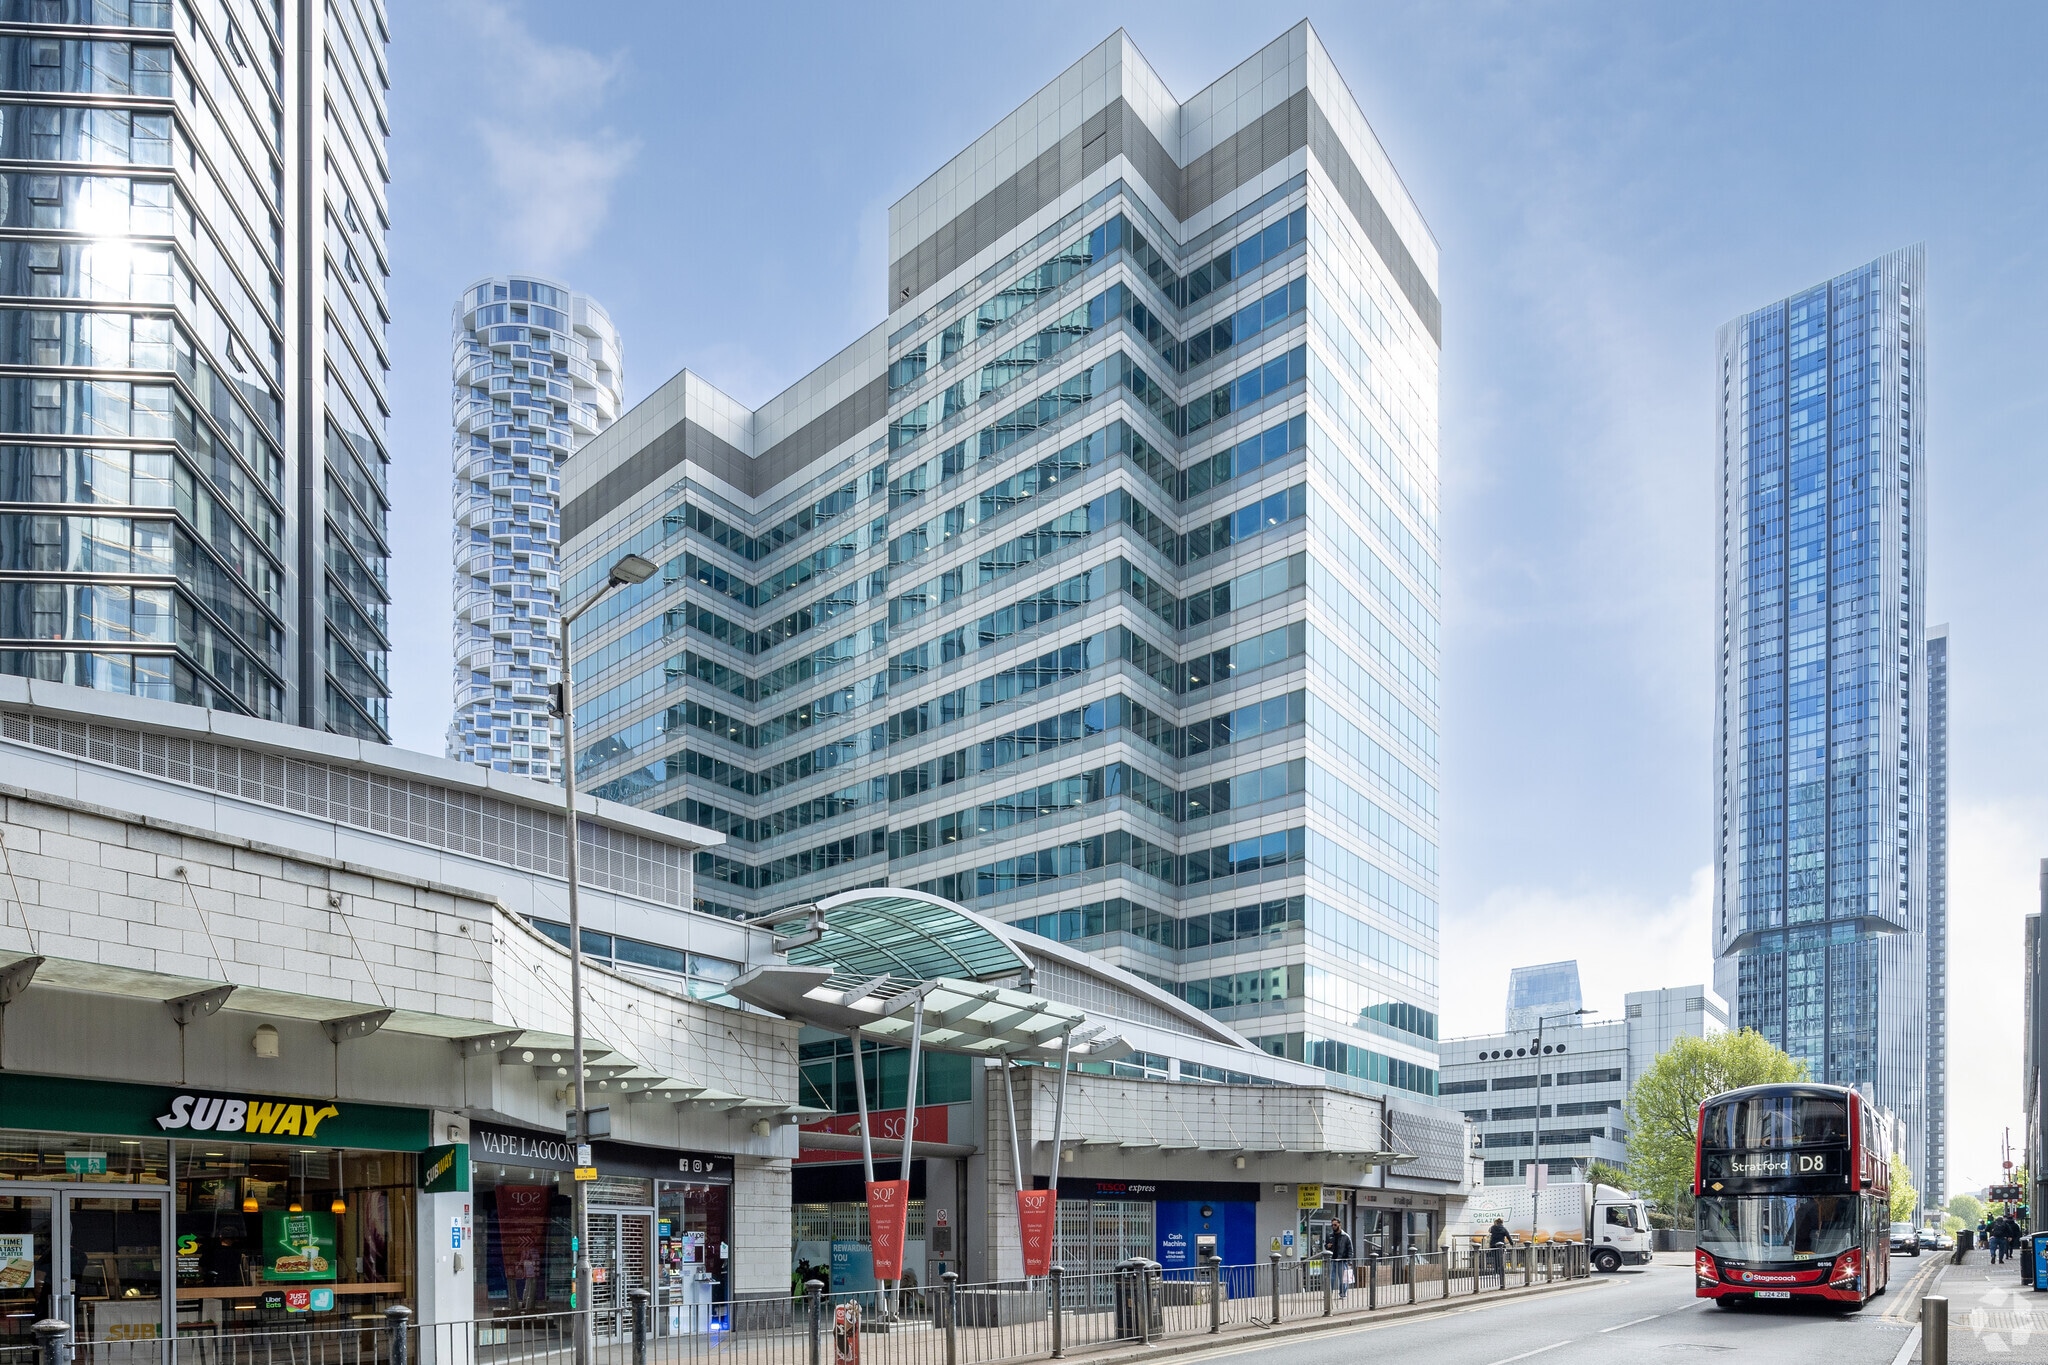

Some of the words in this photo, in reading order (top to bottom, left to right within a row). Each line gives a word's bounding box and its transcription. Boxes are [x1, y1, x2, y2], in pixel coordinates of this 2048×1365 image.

[156, 1095, 339, 1138] SUBWAY
[480, 1131, 518, 1156] VAPE
[521, 1137, 576, 1163] LAGOON
[425, 1149, 455, 1186] SUBWAY
[1731, 1160, 1789, 1172] Stratford
[1800, 1155, 1824, 1172] D8
[873, 1187, 895, 1203] SQP
[1096, 1183, 1126, 1191] TESCO
[1128, 1184, 1156, 1194] express
[1025, 1196, 1046, 1209] SQP
[833, 1244, 873, 1252] REWARDING
[833, 1253, 848, 1262] YOU
[1753, 1274, 1796, 1282] Stagecoach
[289, 1292, 307, 1300] JUST
